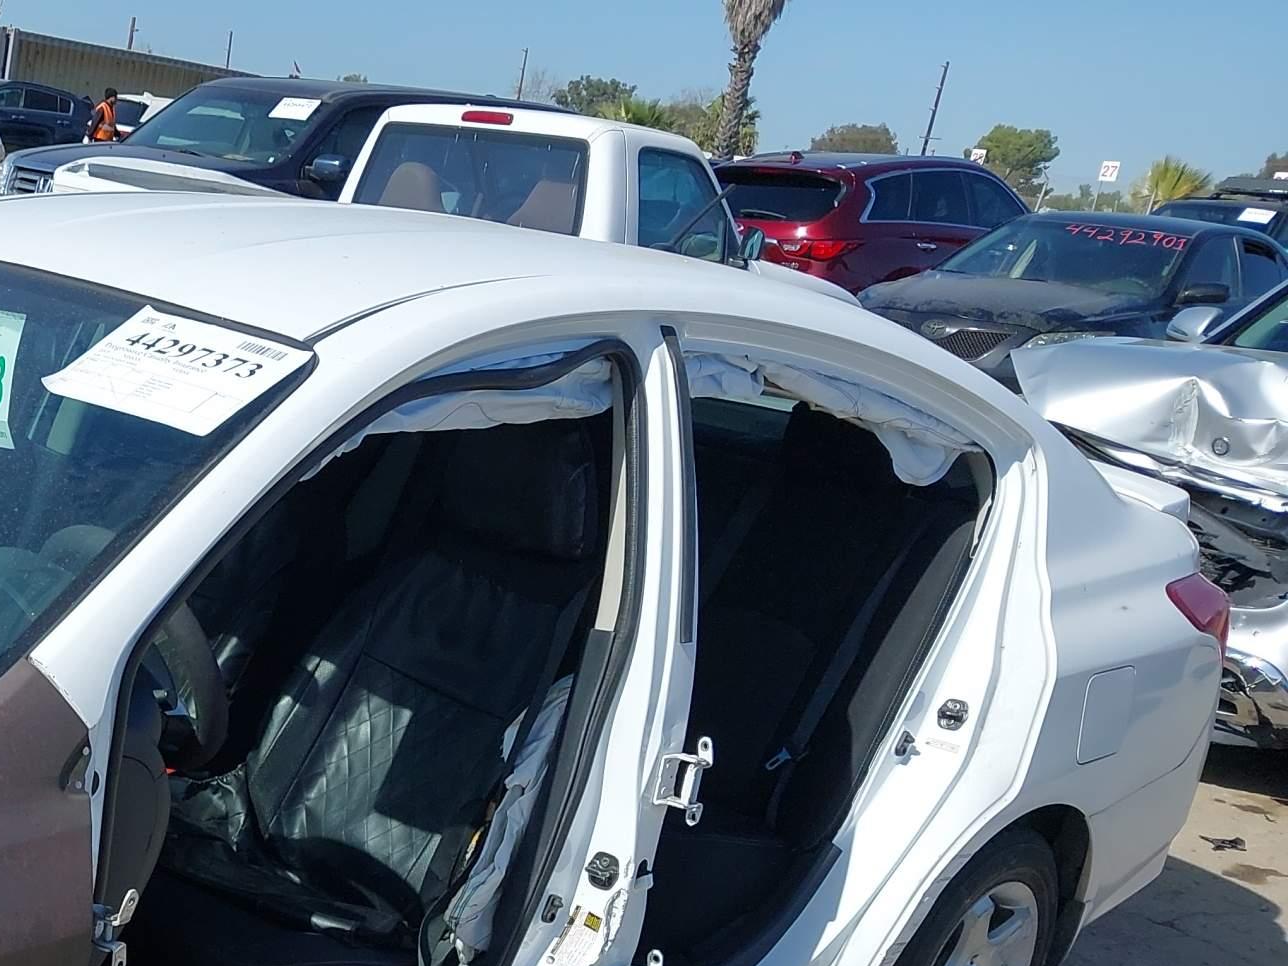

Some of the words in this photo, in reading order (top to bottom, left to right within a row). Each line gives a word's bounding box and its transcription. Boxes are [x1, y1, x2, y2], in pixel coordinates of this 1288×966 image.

[1101, 165, 1118, 177] 27
[1065, 223, 1188, 251] 44292901
[125, 332, 264, 379] 44297373
